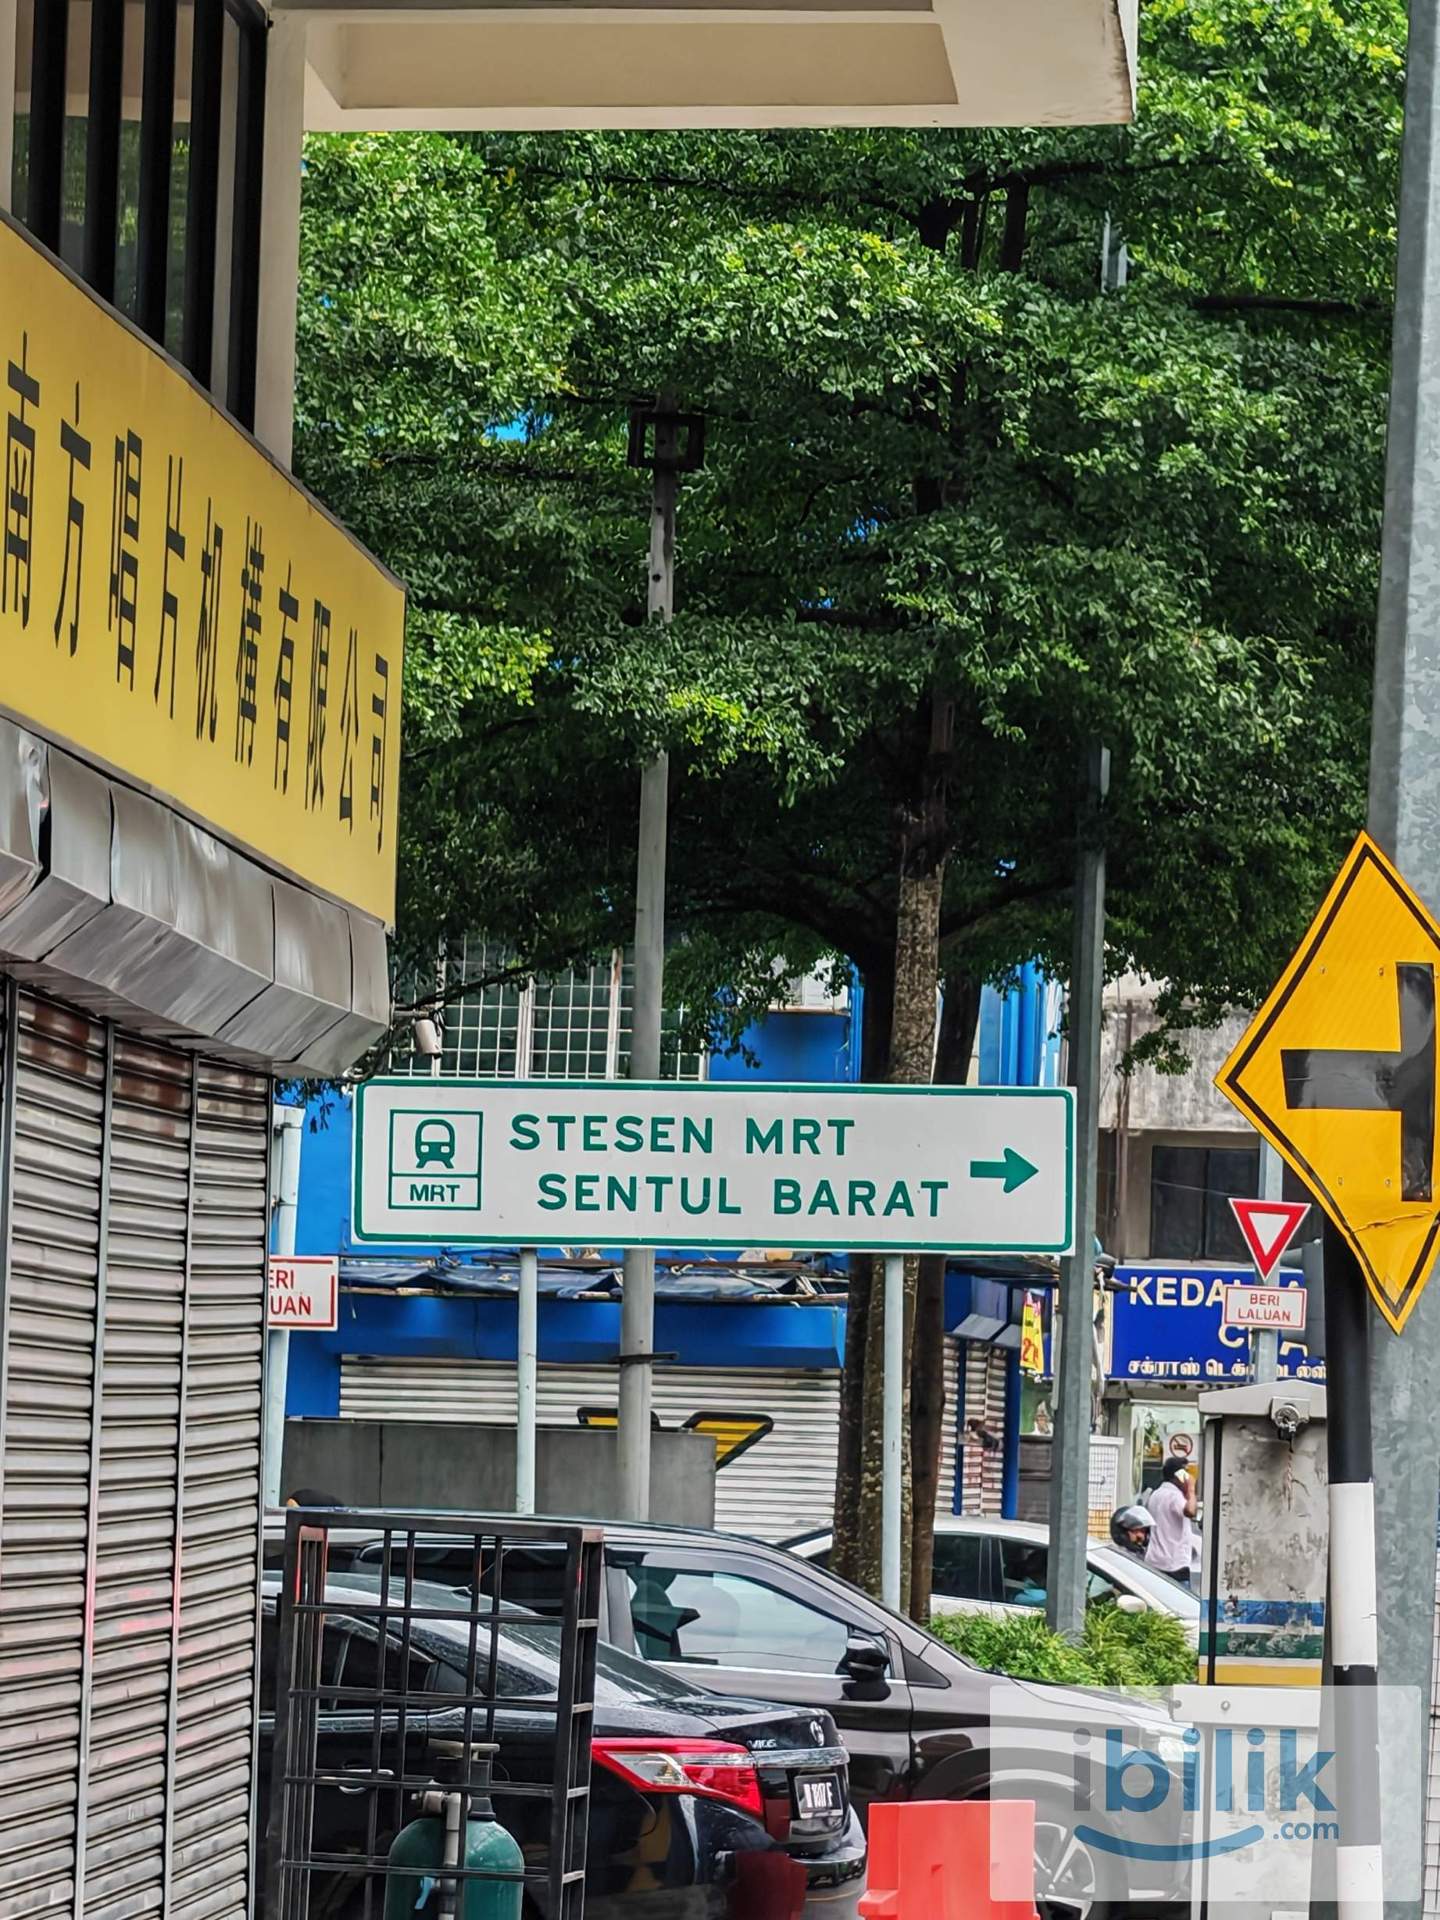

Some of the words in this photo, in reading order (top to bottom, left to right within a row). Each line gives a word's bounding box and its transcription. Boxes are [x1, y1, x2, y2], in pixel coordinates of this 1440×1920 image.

[510, 1114, 713, 1155] STESEN
[747, 1118, 855, 1157] MRT
[409, 1183, 461, 1204] MRT
[537, 1174, 741, 1215] SENTUL
[775, 1180, 949, 1218] BARAT
[1129, 1276, 1241, 1307] KEDA
[1249, 1293, 1281, 1306] BERI
[1237, 1308, 1292, 1322] LALUAN
